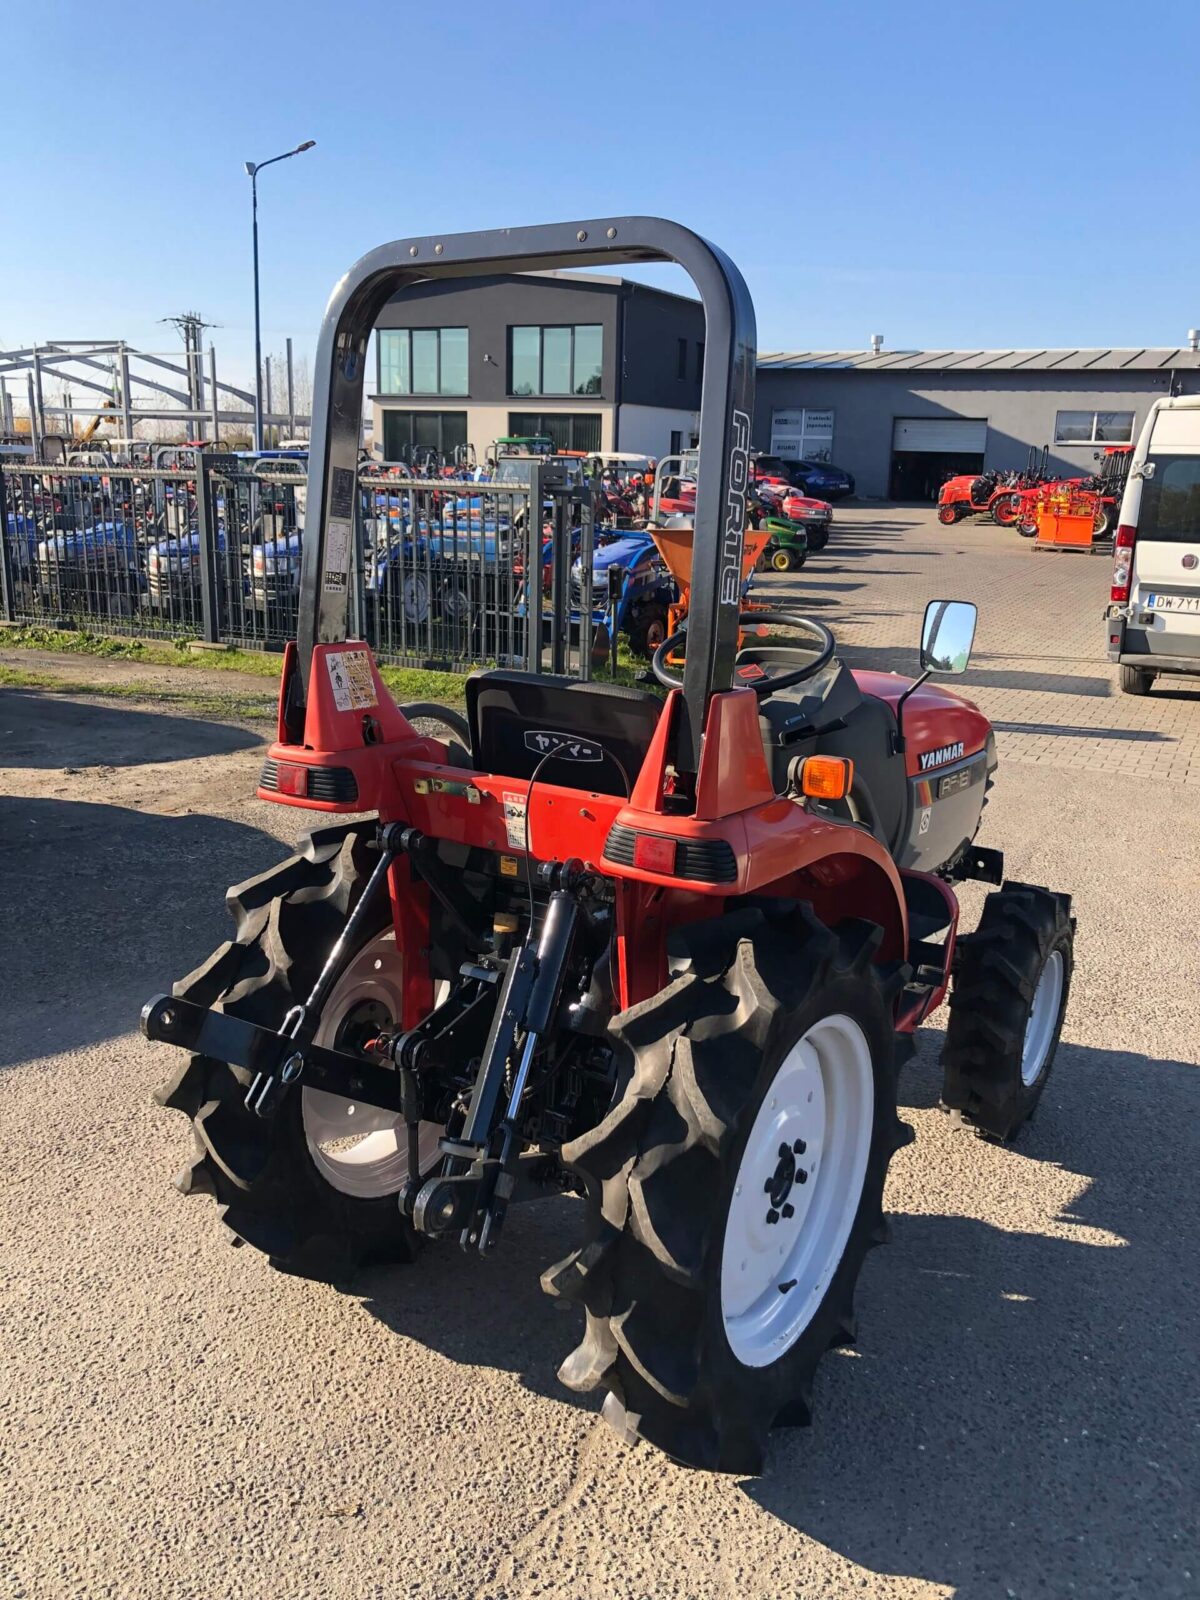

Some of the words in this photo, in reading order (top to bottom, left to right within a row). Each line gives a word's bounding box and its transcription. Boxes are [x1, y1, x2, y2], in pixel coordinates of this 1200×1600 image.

[720, 409, 750, 605] FORTE
[1156, 596, 1173, 608] DW
[920, 742, 964, 769] YANMAR
